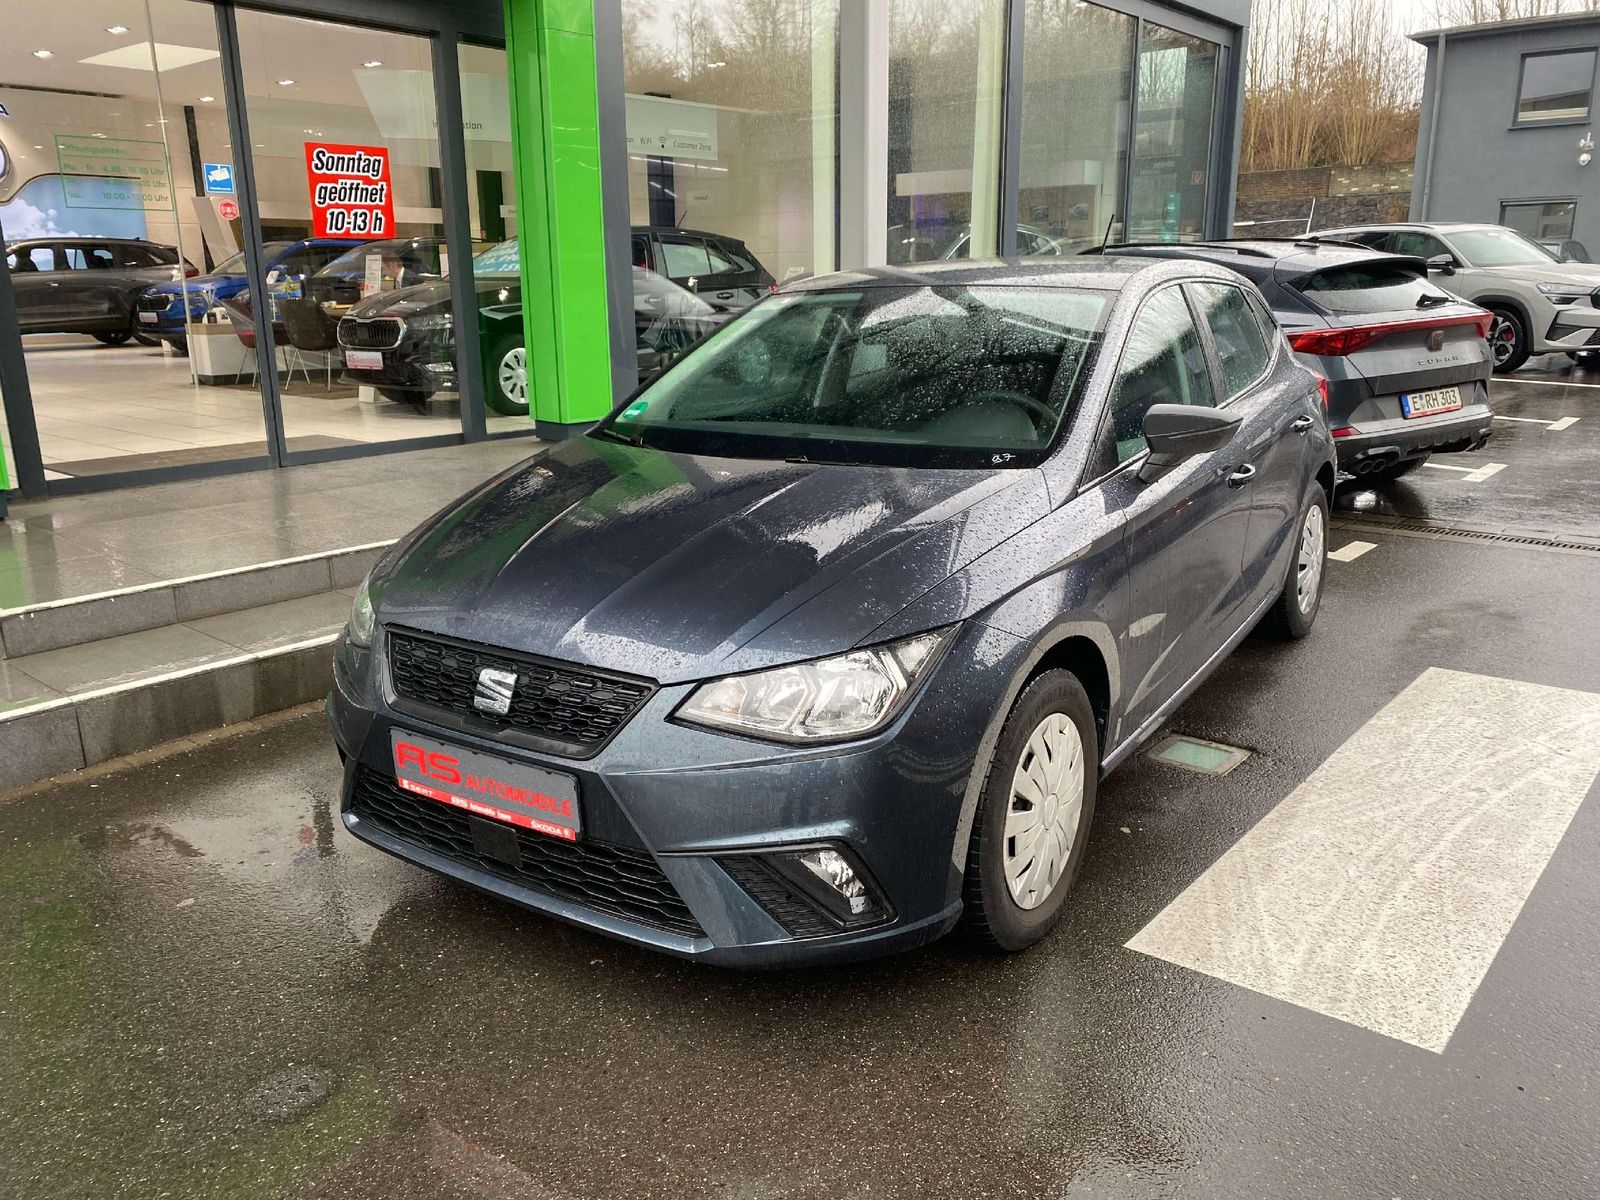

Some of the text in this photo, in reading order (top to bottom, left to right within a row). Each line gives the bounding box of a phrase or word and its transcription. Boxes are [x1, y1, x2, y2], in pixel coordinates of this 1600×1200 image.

[313, 149, 382, 178] Sonntag
[154, 194, 169, 202] Uhr
[316, 181, 385, 206] geöffnet
[327, 210, 384, 232] 10-13 h
[1411, 389, 1457, 411] E RH 303
[465, 774, 574, 818] AUTOMOBILE
